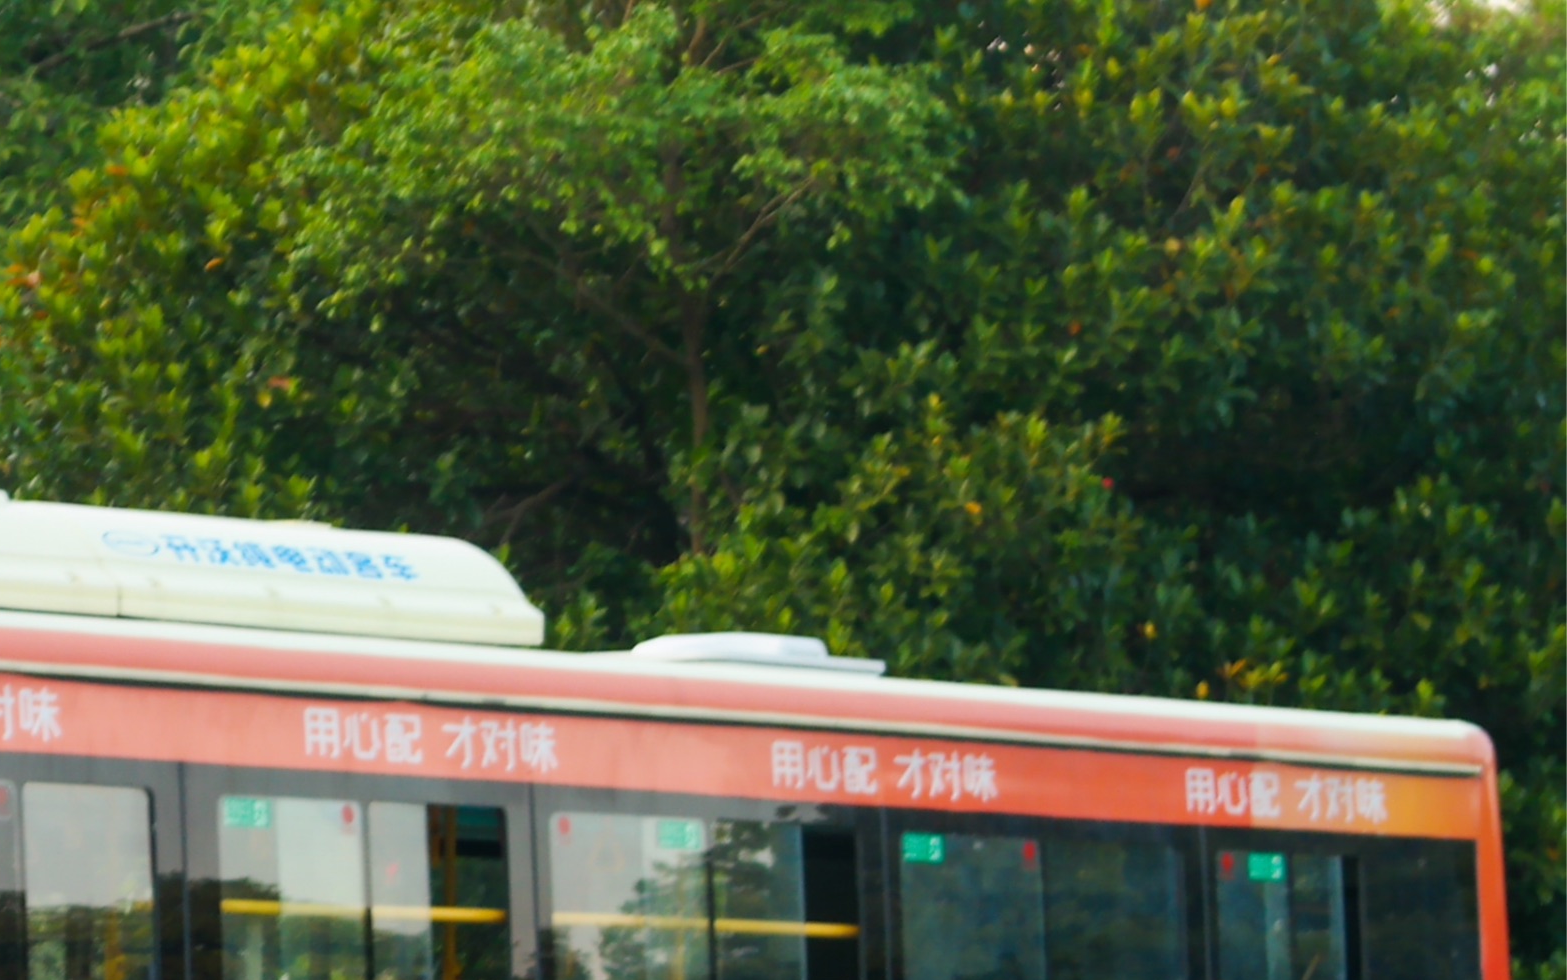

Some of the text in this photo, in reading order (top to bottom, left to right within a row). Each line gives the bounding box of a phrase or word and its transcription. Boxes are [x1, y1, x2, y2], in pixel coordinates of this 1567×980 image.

[303, 706, 559, 774] 用心配 才对味
[771, 740, 1000, 802] 用心配 才对味
[1185, 768, 1388, 824] 用心配 才对味
